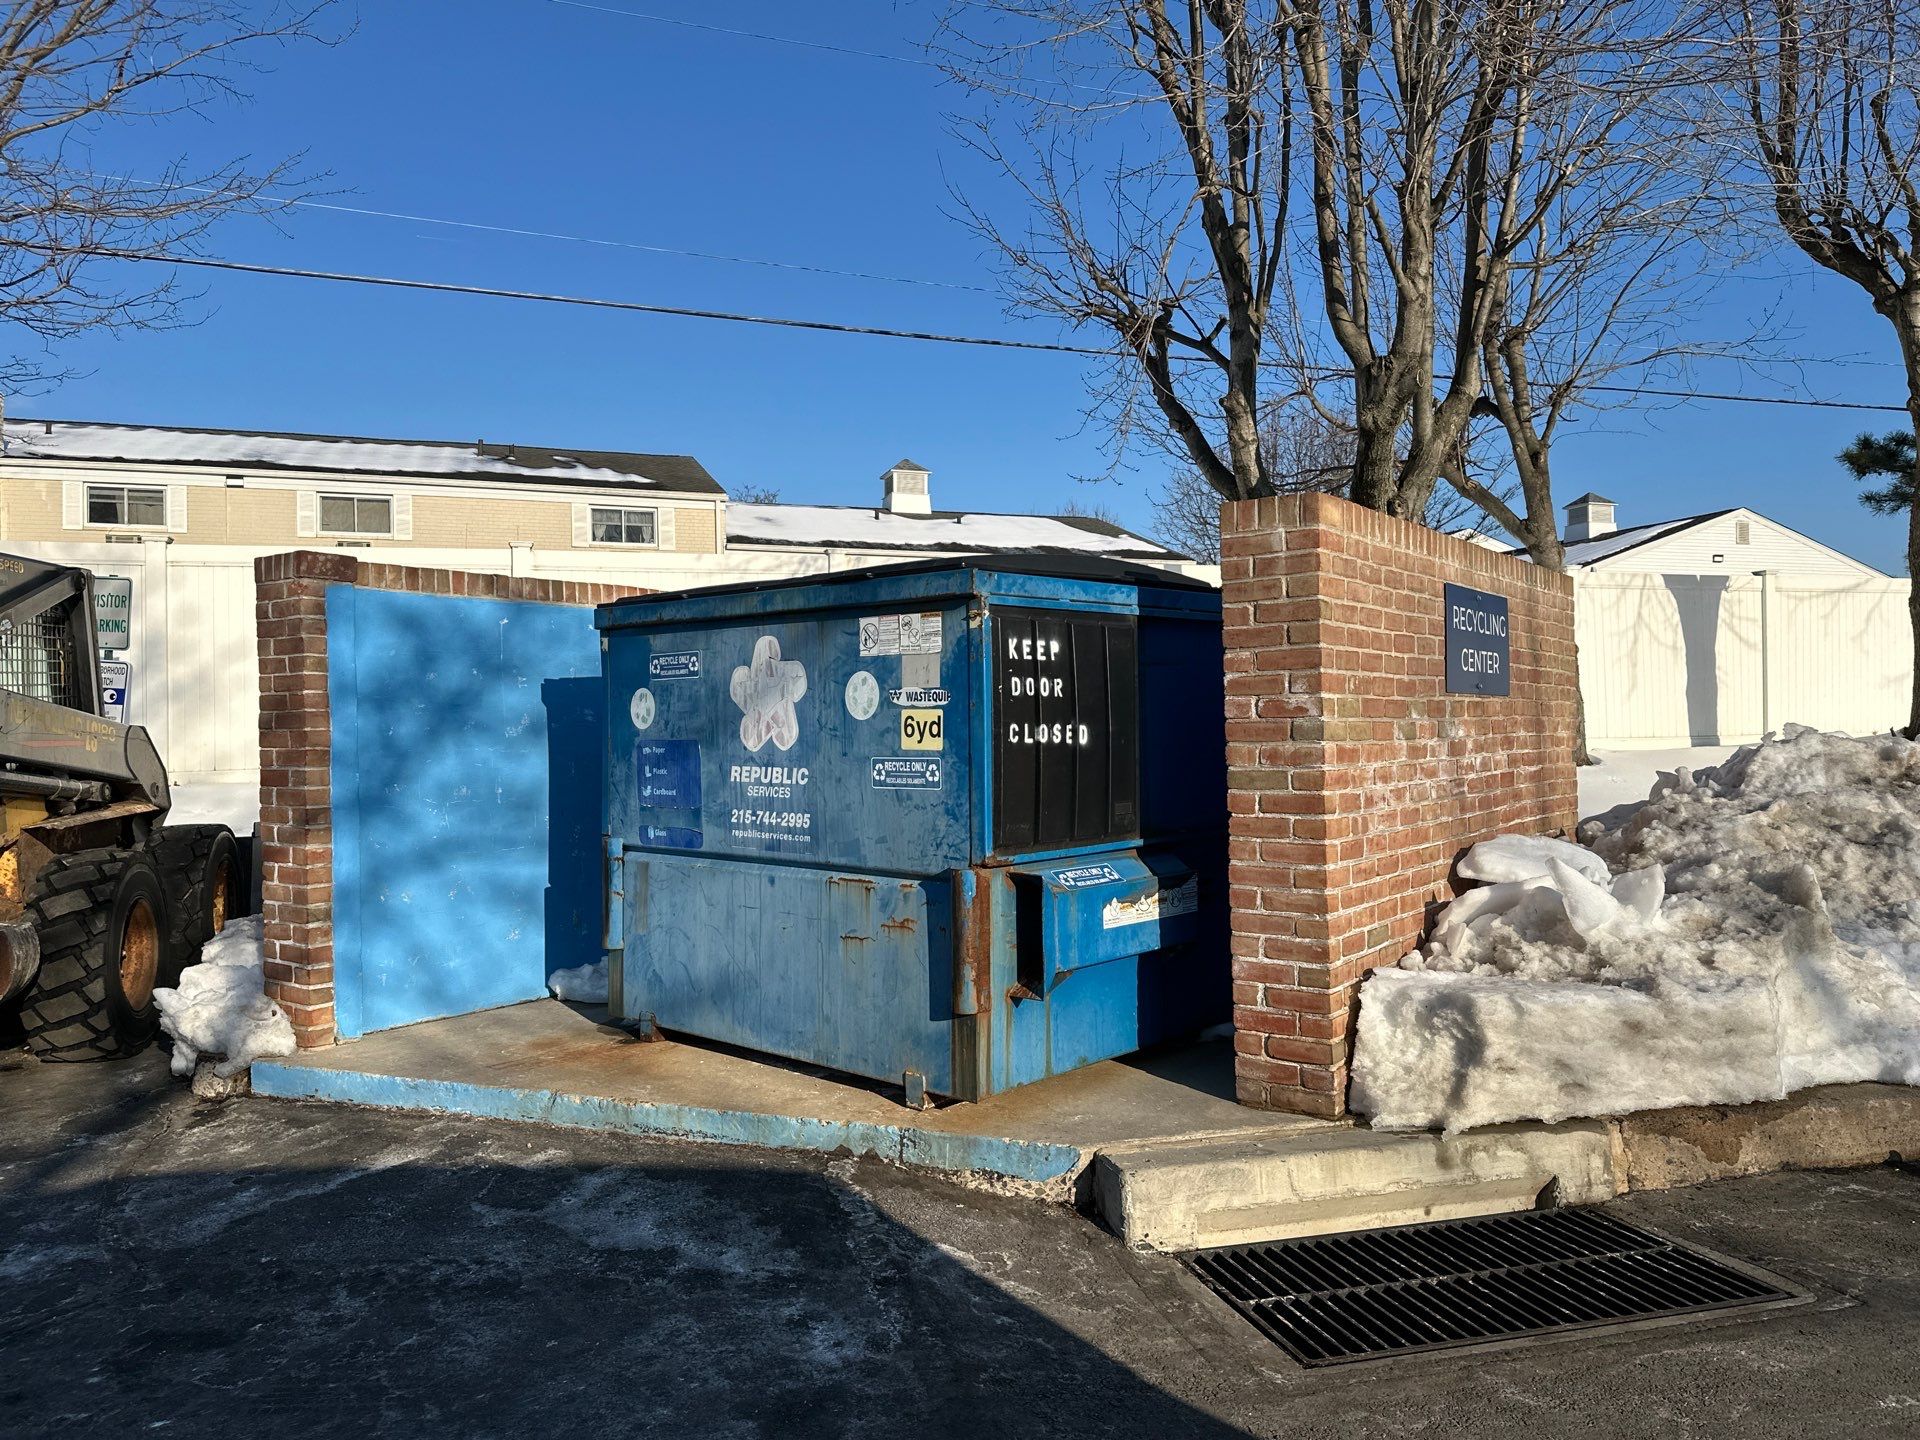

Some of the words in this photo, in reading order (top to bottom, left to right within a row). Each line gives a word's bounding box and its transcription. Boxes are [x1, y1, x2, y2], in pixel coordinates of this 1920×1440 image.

[96, 618, 126, 633] RKING
[1453, 605, 1506, 637] RECYCLING
[1008, 637, 1060, 661] KEEP
[660, 657, 678, 665] RECYCLE
[1461, 648, 1500, 669] CENTER
[103, 677, 114, 686] TCH
[1011, 676, 1063, 698] DOOR
[904, 715, 941, 744] 6yd
[1009, 723, 1089, 745] CLOSED
[652, 746, 666, 755] Paper
[652, 767, 668, 775] Plastic
[884, 761, 910, 771] RECYCLE
[911, 762, 927, 771] ONLY
[730, 765, 809, 785] REPUBLIC
[653, 787, 677, 796] Cardboard
[747, 785, 791, 798] SERVICES
[731, 808, 811, 829] 215-744-2995
[655, 828, 667, 837] Glass
[731, 829, 811, 842] republicservices.com
